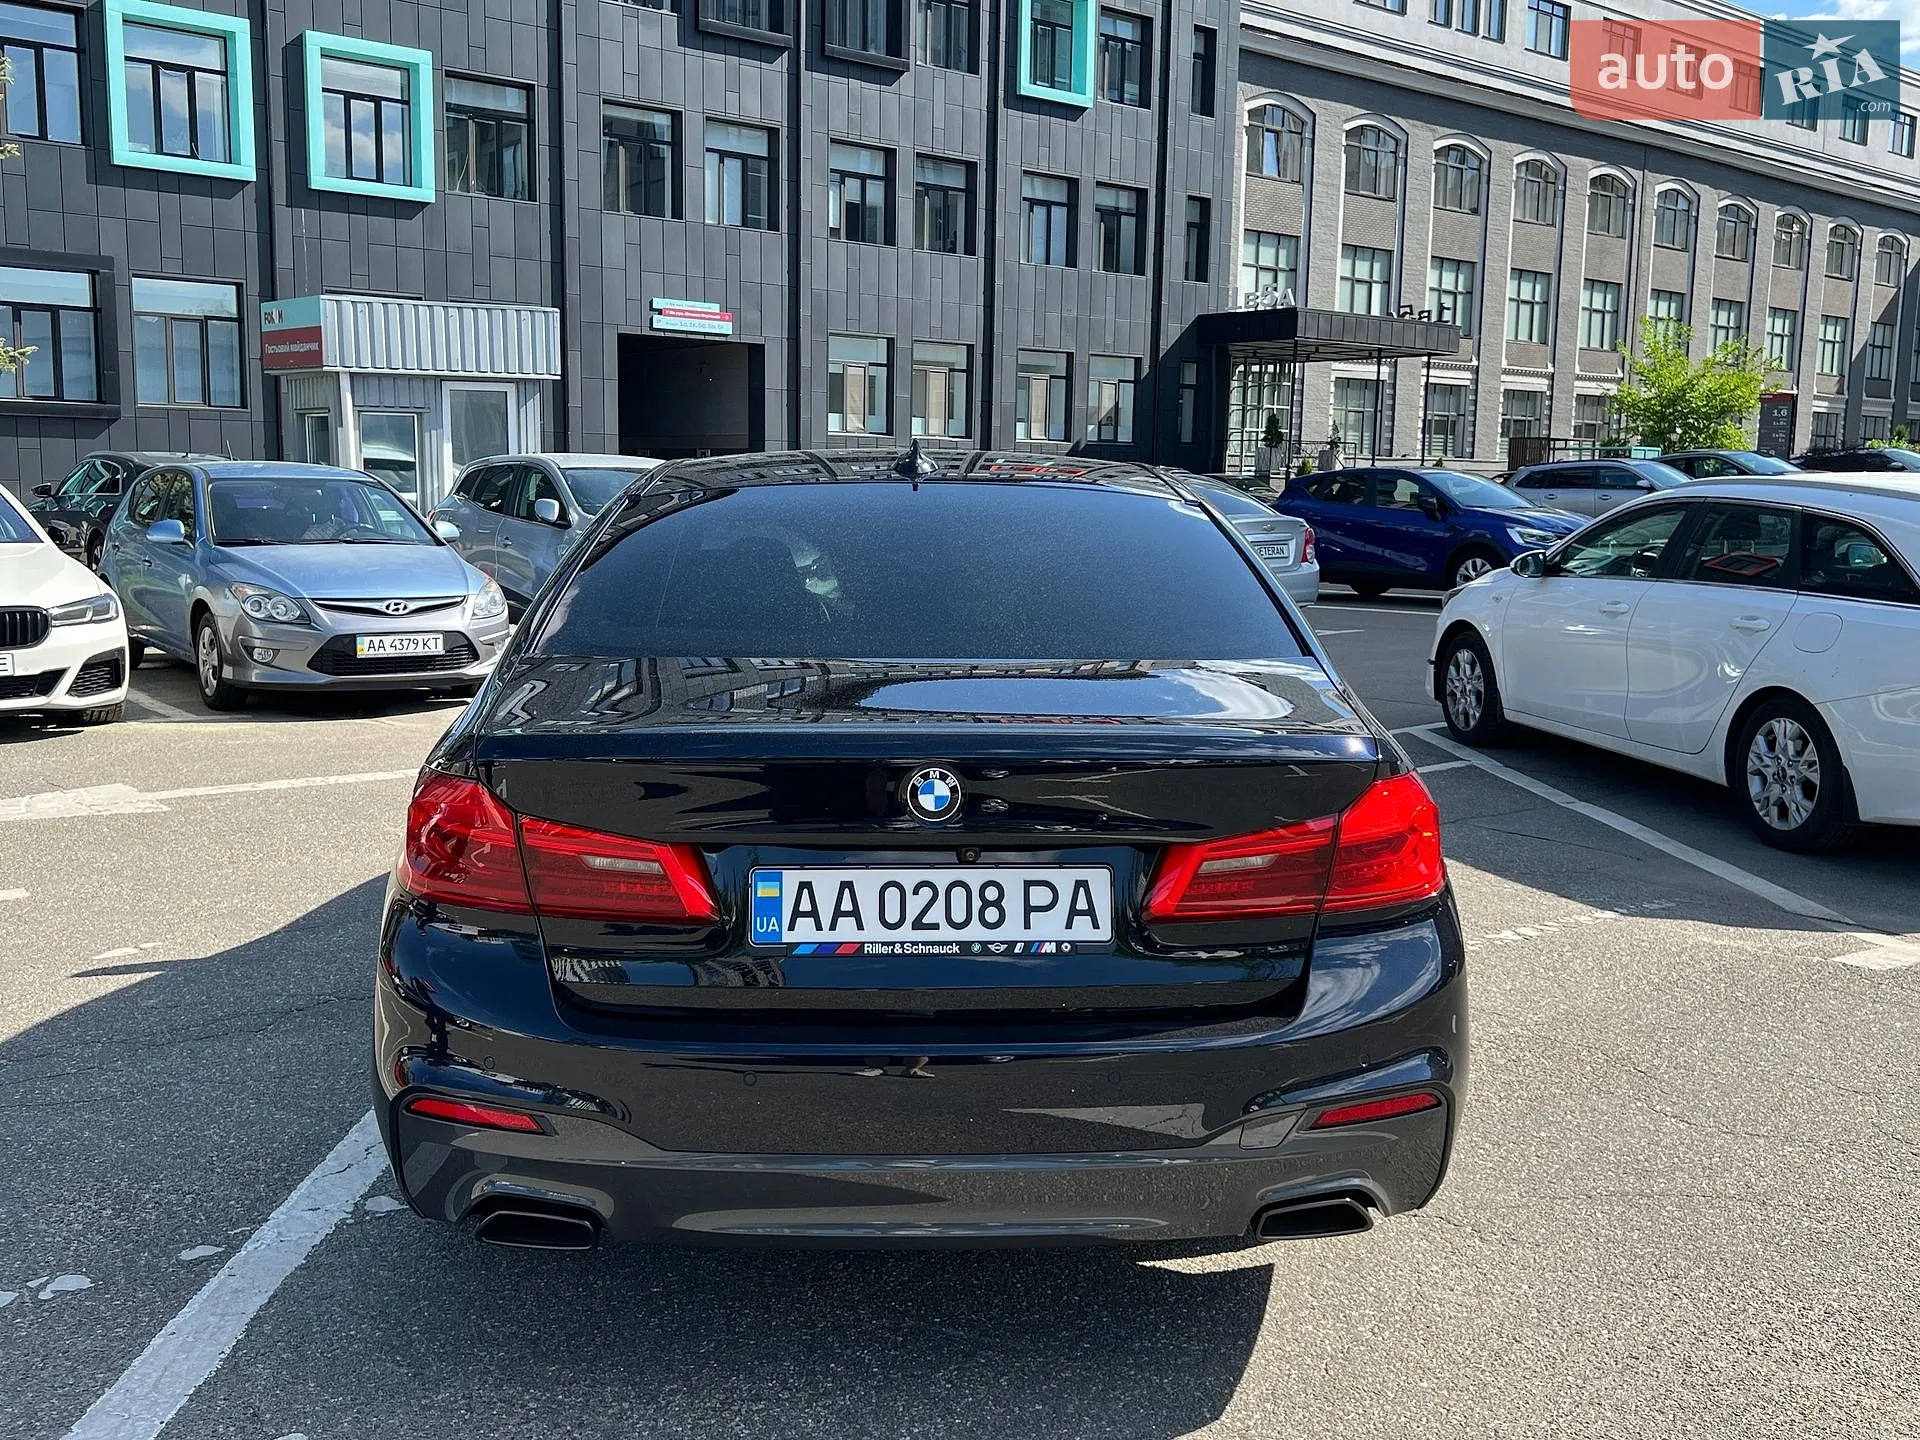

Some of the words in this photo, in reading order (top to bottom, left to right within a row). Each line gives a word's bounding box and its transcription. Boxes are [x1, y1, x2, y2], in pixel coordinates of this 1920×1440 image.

[367, 639, 386, 652] AA
[389, 638, 419, 651] 4379
[422, 637, 441, 650] KT
[913, 770, 957, 788] BMW
[787, 880, 865, 932] AA
[878, 880, 1006, 931] 0208
[1023, 879, 1101, 930] PA
[756, 917, 779, 933] UA
[864, 942, 960, 954] Riller&Schnauck
